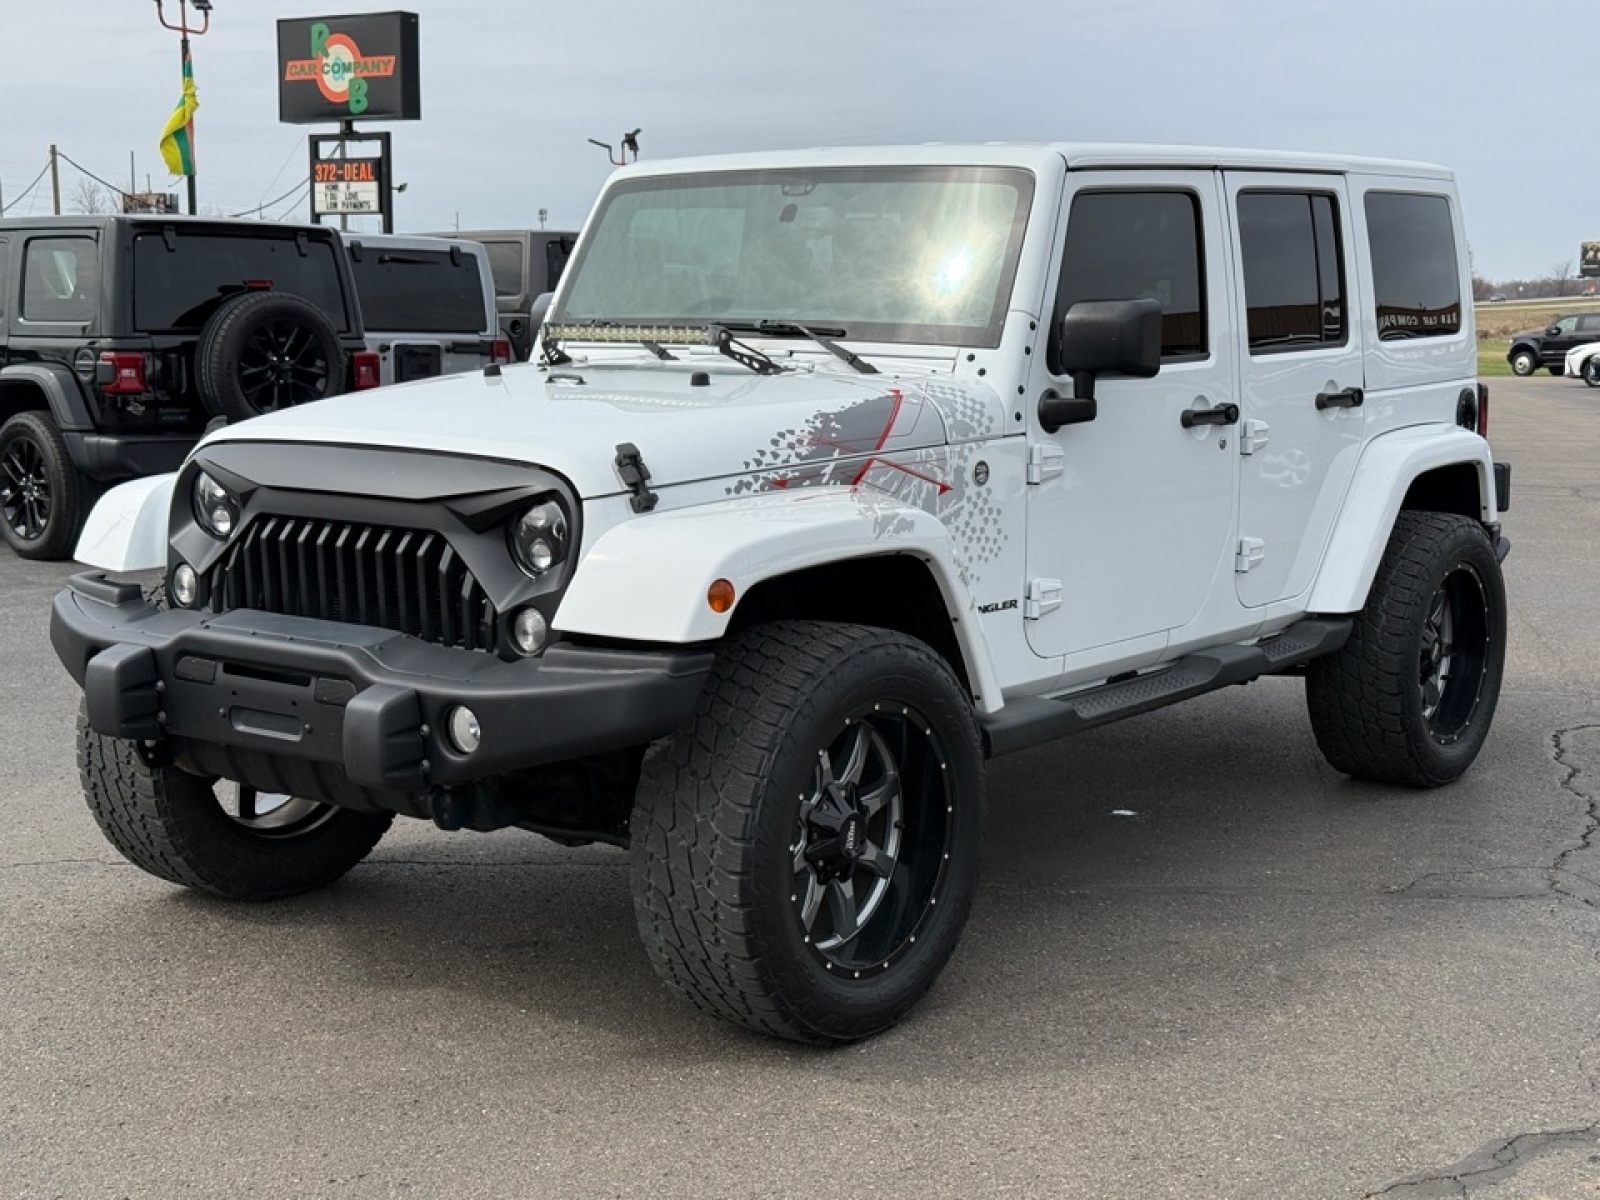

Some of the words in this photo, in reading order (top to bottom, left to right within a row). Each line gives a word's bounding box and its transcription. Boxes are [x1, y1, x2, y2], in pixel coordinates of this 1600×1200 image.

[288, 64, 316, 76] CAR
[321, 60, 393, 76] COMPANY
[310, 22, 331, 58] R
[348, 77, 369, 115] B
[314, 163, 375, 182] 372-DEAL
